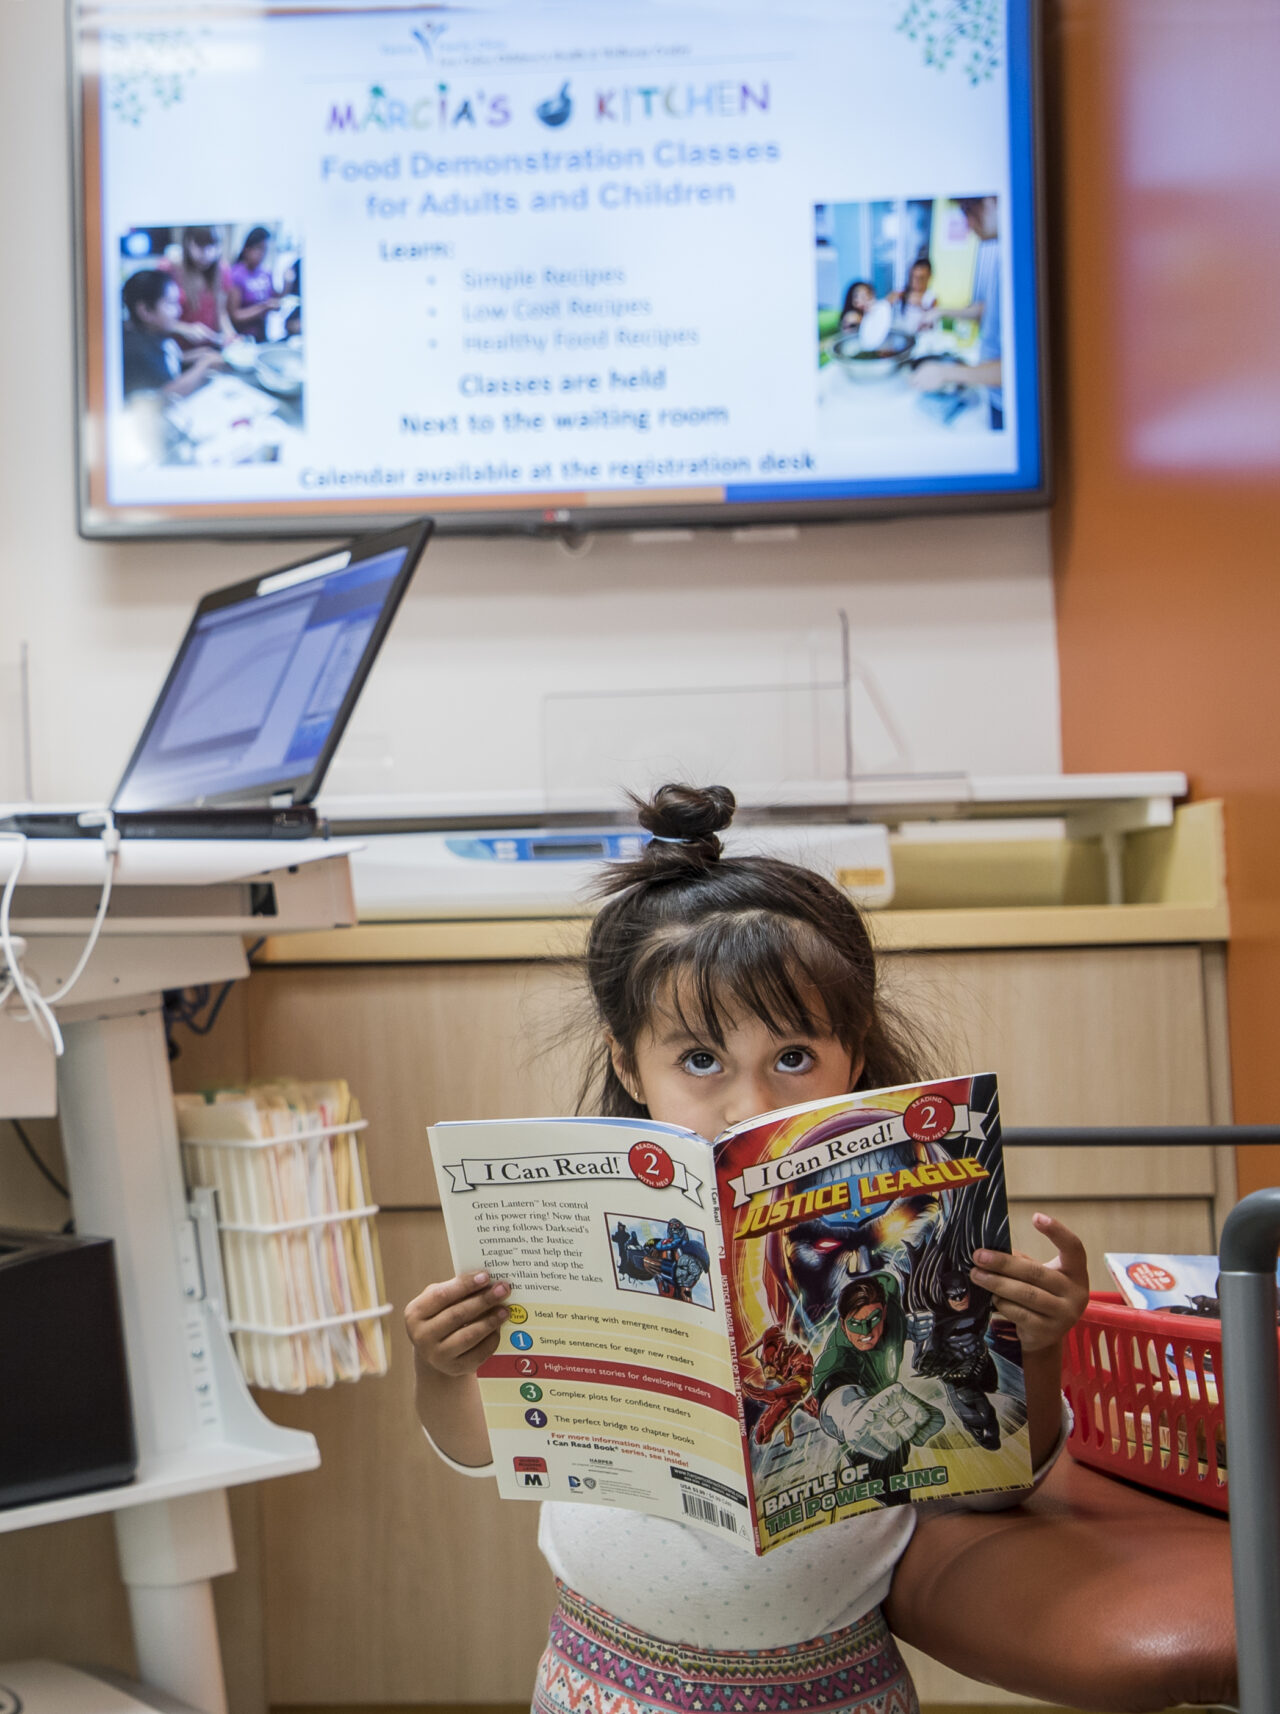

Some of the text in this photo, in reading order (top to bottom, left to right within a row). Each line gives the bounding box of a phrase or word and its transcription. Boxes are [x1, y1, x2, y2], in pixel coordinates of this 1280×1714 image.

[596, 82, 770, 124] KITCHEN
[321, 139, 781, 182] Food Demonstration Classes
[366, 181, 736, 219] for Adults and Children
[462, 267, 626, 291] Simple Recipes
[462, 297, 653, 323] Low Cost Recipes
[464, 326, 700, 355] Healthy Food Recipes
[458, 368, 667, 397] Classes are held
[400, 404, 731, 434] Next to the waiting room
[300, 451, 816, 489] Calendar available at the registration desk
[920, 1105, 938, 1129] 2
[643, 1152, 661, 1177] 2
[760, 1123, 894, 1187] I Can Read!
[483, 1156, 620, 1182] I Can Read!
[472, 1200, 499, 1210] Green
[541, 1199, 557, 1208] lost
[559, 1200, 589, 1210] control
[734, 1157, 990, 1239] JUSTICE LEAGUE
[474, 1211, 591, 1222] of his power ring! Now that
[476, 1223, 590, 1234] the ring follows Darkseid's
[479, 1235, 575, 1245] commands, the Justice
[520, 1248, 541, 1256] must
[543, 1247, 562, 1258] help
[563, 1248, 584, 1258] their
[483, 1259, 585, 1271] fellow hero and stop the
[487, 1270, 604, 1283] uper-villain before he takes
[508, 1281, 562, 1292] the universe.
[534, 1310, 690, 1339] Ideal for sharing with emergent readers
[516, 1332, 527, 1347] 1
[539, 1336, 695, 1367] Simple sentences for eager new readers
[519, 1358, 533, 1374] 2
[526, 1384, 537, 1400] 3
[544, 1362, 712, 1399] High-interest stories for developing readers
[549, 1389, 692, 1419] Complex plots for confident readers
[529, 1410, 542, 1426] 4
[553, 1414, 696, 1446] The perfect bridge to chapter books
[551, 1432, 681, 1458] For more information about the
[552, 1439, 569, 1448] Can
[570, 1441, 592, 1450] Read
[649, 1452, 663, 1461] see
[664, 1454, 690, 1468] inside!
[524, 1473, 543, 1487] M
[764, 1471, 837, 1517] BATTLE
[839, 1463, 870, 1485] OF
[765, 1504, 804, 1536] THE
[806, 1479, 884, 1518] POWER
[888, 1466, 948, 1492] RING
